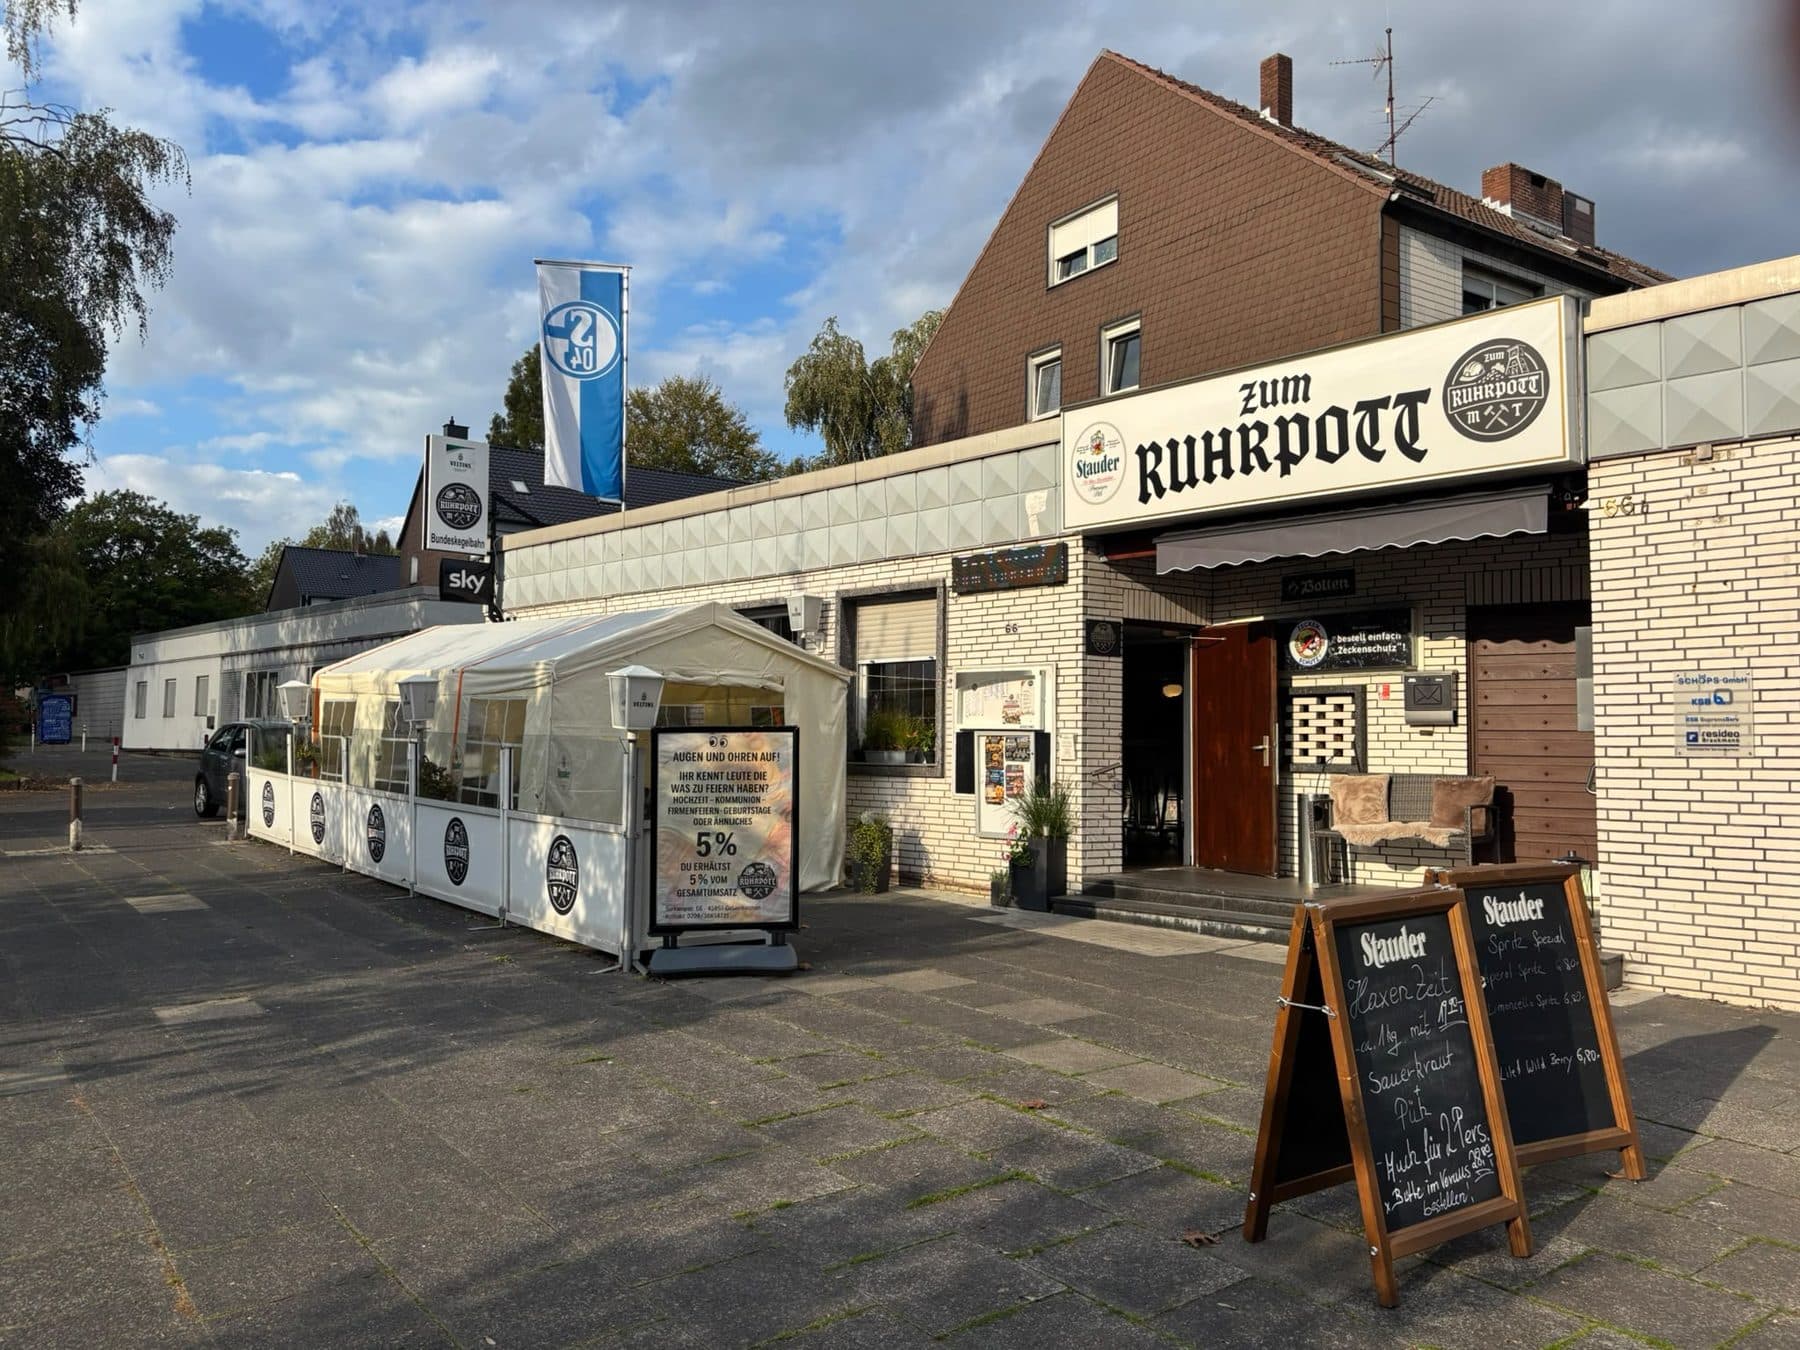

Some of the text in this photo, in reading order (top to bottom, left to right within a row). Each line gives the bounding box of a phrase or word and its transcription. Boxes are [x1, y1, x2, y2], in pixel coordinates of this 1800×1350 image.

[1451, 375, 1540, 408] RUHRPOTT
[1512, 403, 1523, 417] T
[1134, 387, 1432, 505] RUHRPOTT
[1076, 454, 1120, 479] Stauder
[440, 500, 478, 514] RUHRPOTT
[431, 532, 485, 549] Bundeskegelbahn
[449, 569, 486, 594] sky
[1005, 623, 1018, 634] 66
[1691, 697, 1711, 705] KSB
[1702, 729, 1740, 738] resideo
[672, 751, 781, 763] AUGEN UND OHREN AUF!
[679, 771, 768, 781] IHR KENNT LEUTE DIE
[671, 783, 769, 794] WAS ZU FEIERN HABEN?
[673, 796, 709, 805] HOCHZEIT
[715, 795, 761, 804] KOMMUNION
[668, 807, 720, 815] FIRMENFEIERN
[723, 806, 772, 815] GEBURTSTAGE
[693, 817, 713, 826] ODER
[680, 862, 731, 872] DU ERHÄLTST
[710, 875, 728, 884] VOM
[676, 888, 738, 898] GESAMTUMSATZ
[1482, 891, 1545, 927] Stauder
[1360, 924, 1427, 968] Stauder
[1487, 931, 1529, 960] Spritz
[1347, 976, 1413, 1020] Haxen
[1368, 1040, 1454, 1094] Sauerkraut
[1423, 1127, 1442, 1175] für
[1425, 1179, 1440, 1195] im
